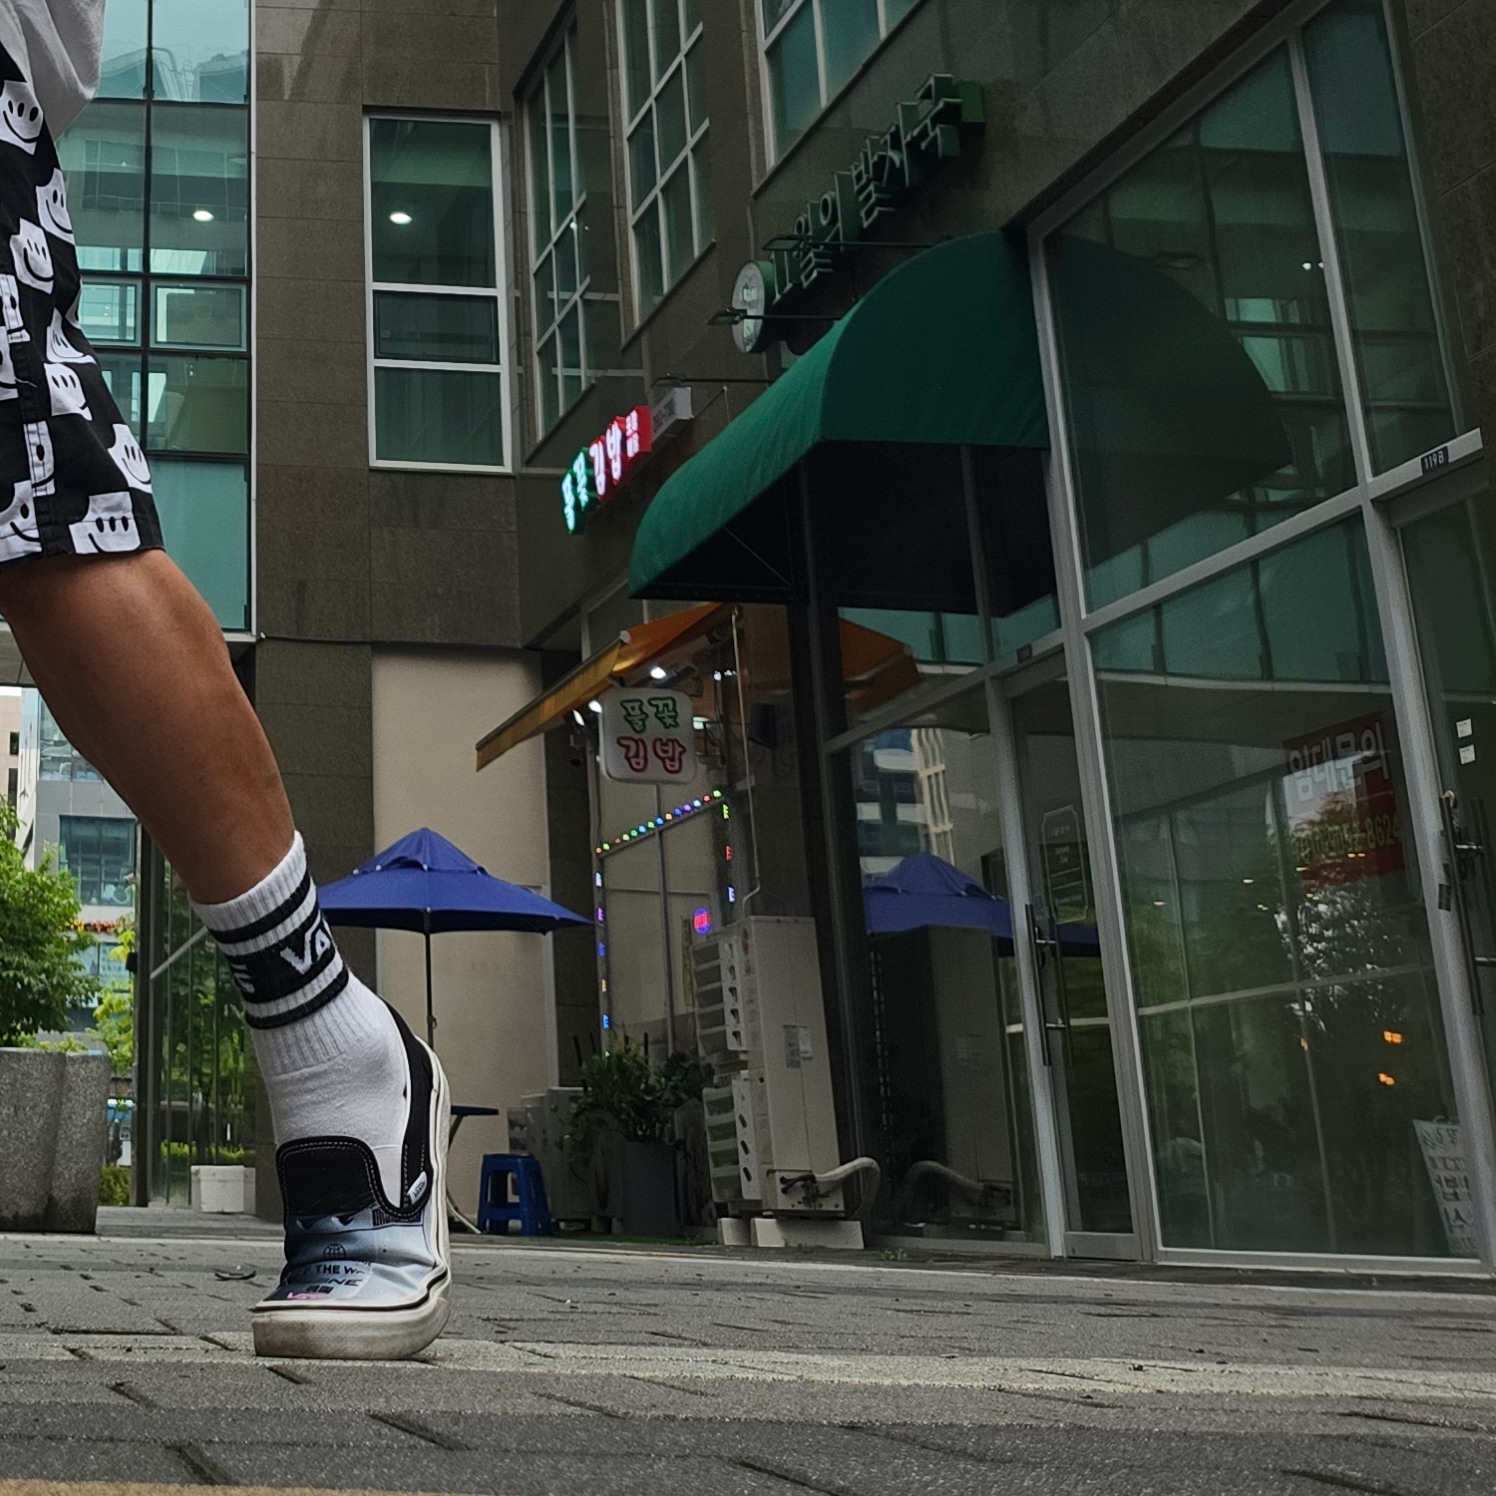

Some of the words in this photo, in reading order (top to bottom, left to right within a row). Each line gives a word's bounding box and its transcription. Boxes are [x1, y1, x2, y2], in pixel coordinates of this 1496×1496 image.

[620, 696, 680, 733] 풀꽃
[616, 736, 687, 774] 김밥
[1289, 719, 1390, 802] 임대문의
